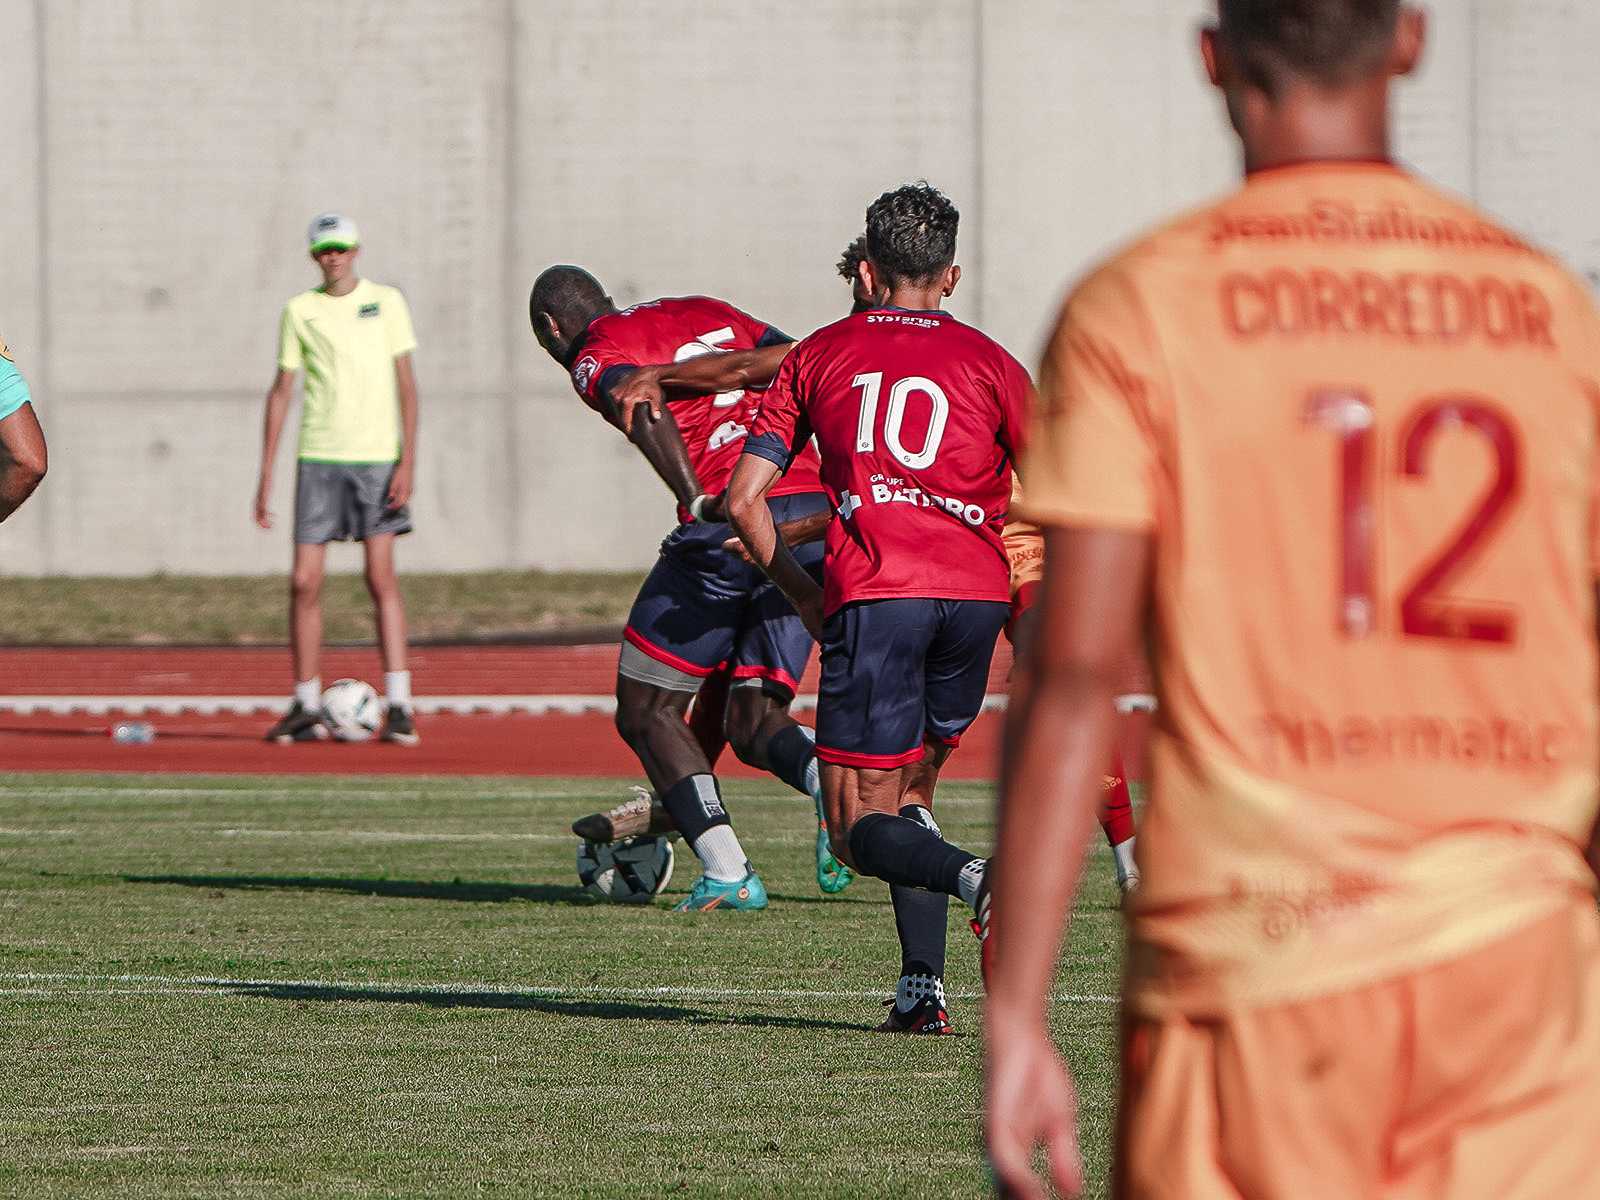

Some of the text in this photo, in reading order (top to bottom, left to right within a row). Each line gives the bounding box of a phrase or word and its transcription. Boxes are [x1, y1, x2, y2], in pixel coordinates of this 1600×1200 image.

[1218, 267, 1556, 350] CORREDOR
[851, 371, 950, 470] 10
[1299, 386, 1522, 650] 12
